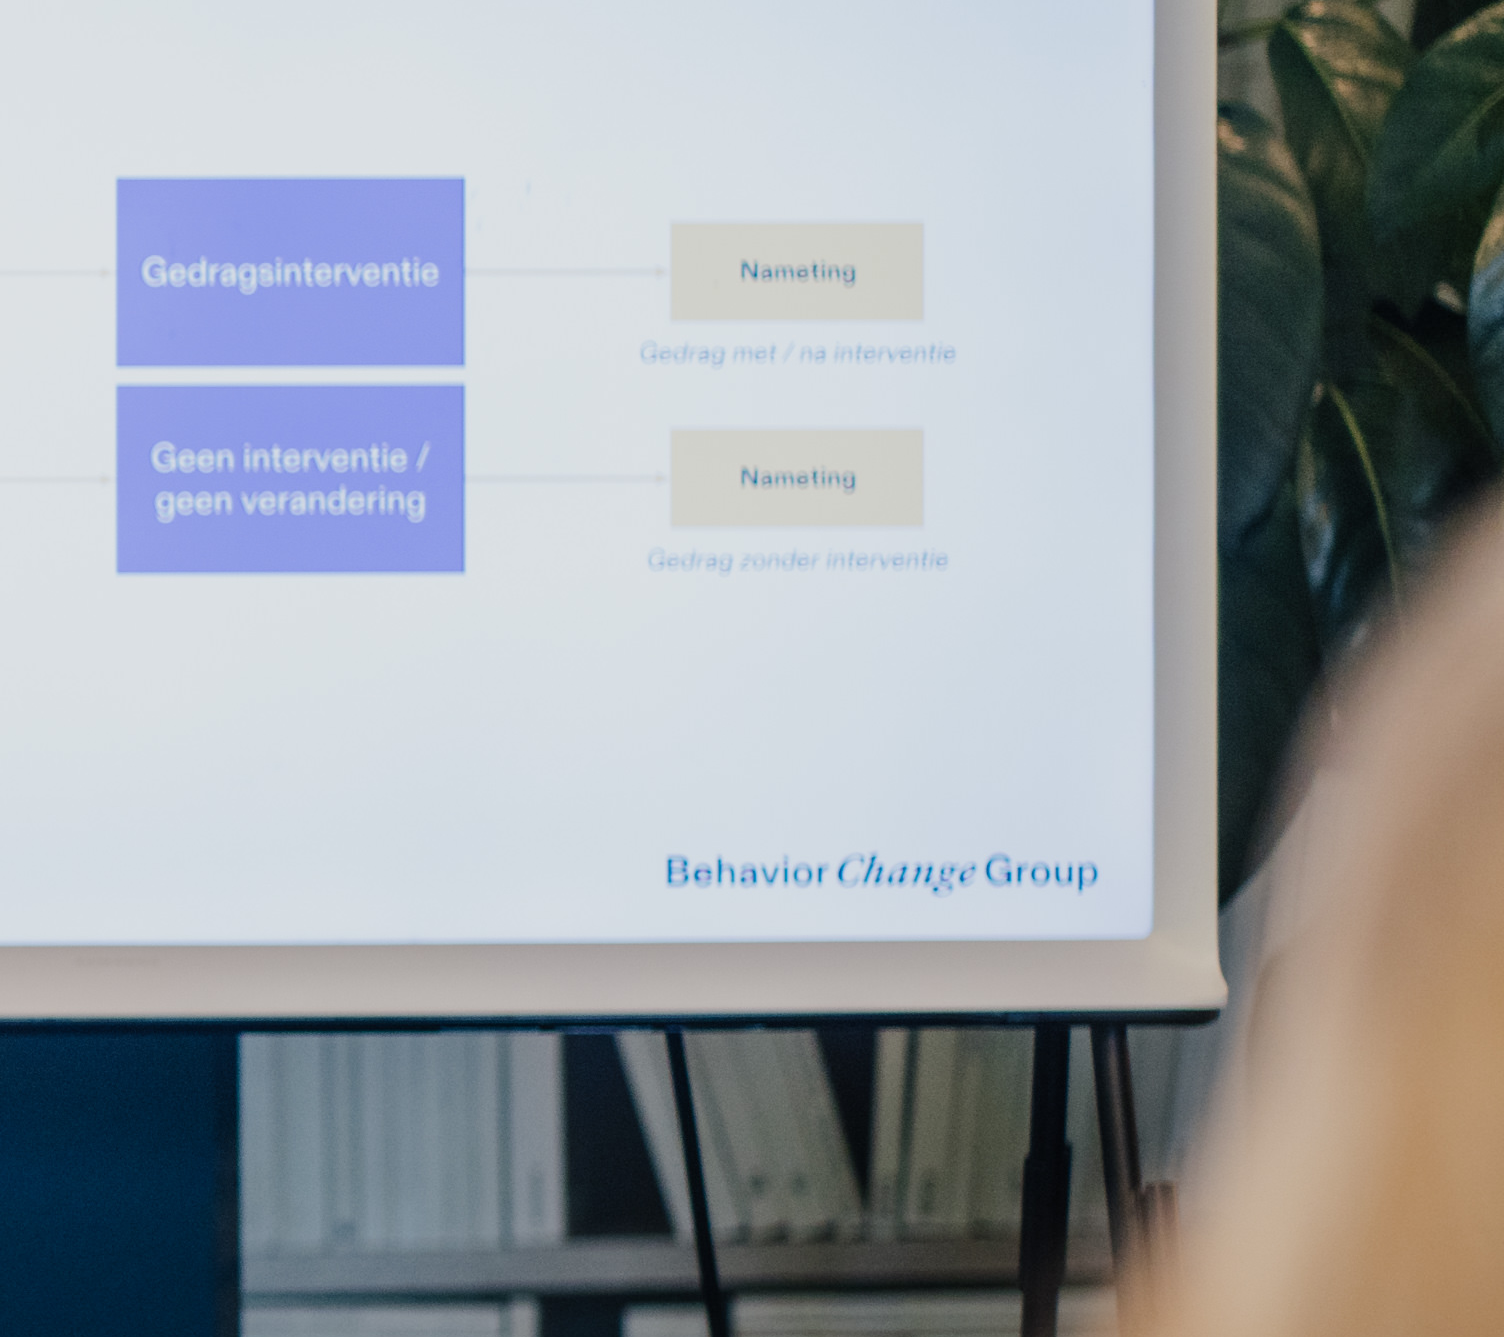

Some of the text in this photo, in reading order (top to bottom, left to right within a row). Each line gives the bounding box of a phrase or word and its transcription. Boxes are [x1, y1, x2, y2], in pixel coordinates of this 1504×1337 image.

[141, 254, 440, 295] Gedragsinterventie
[740, 260, 857, 286] Nameting
[639, 341, 727, 368] Gedrag
[732, 344, 777, 363] met
[799, 346, 827, 364] na
[833, 343, 957, 364] interventie
[150, 440, 235, 474] Geen
[243, 443, 408, 473] interventie
[740, 466, 857, 492] Nameting
[155, 485, 427, 524] geen verandering
[647, 548, 949, 575] Gedrag zonder interventie
[666, 854, 1099, 894] Behavior Change Group
